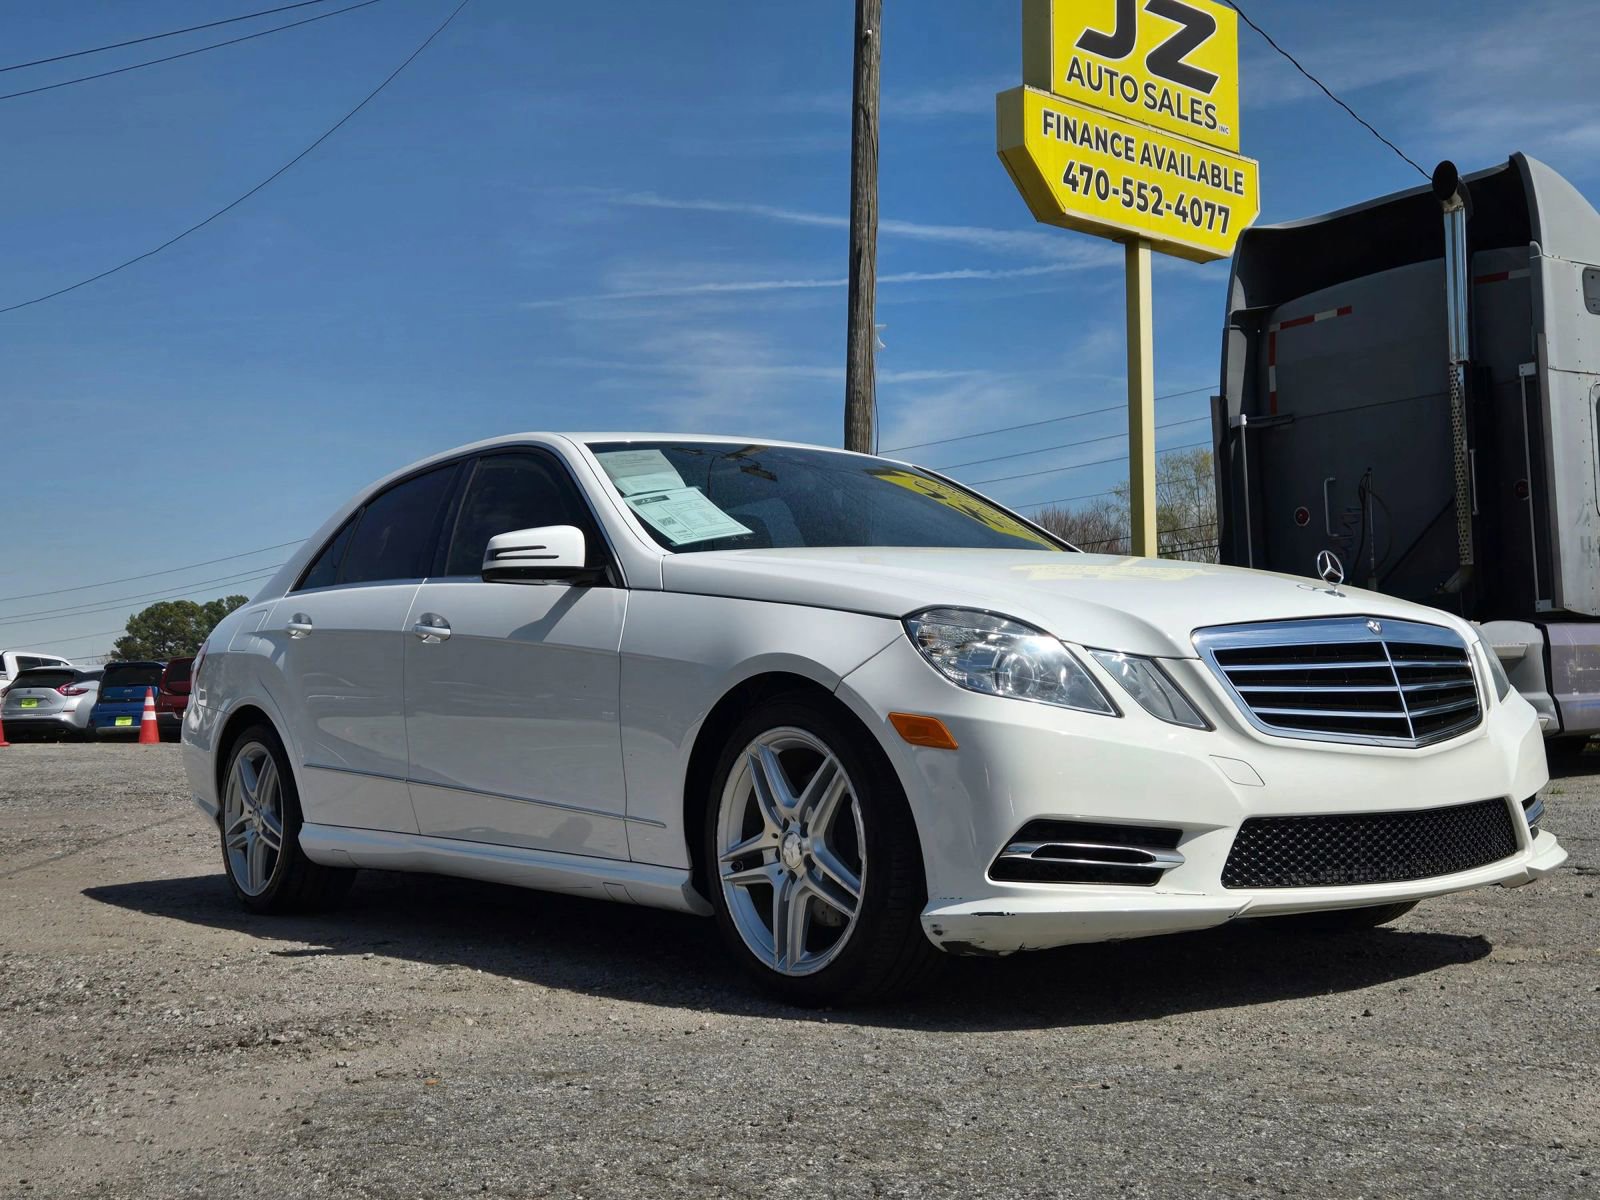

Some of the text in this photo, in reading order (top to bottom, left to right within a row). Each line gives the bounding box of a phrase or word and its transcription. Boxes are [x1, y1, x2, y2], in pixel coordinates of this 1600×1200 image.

[1075, 0, 1219, 94] JZ
[1067, 57, 1217, 130] AUTO SALES
[1043, 110, 1244, 195] FINANCE AVAILABLE
[1063, 161, 1230, 234] 470-552-4077
